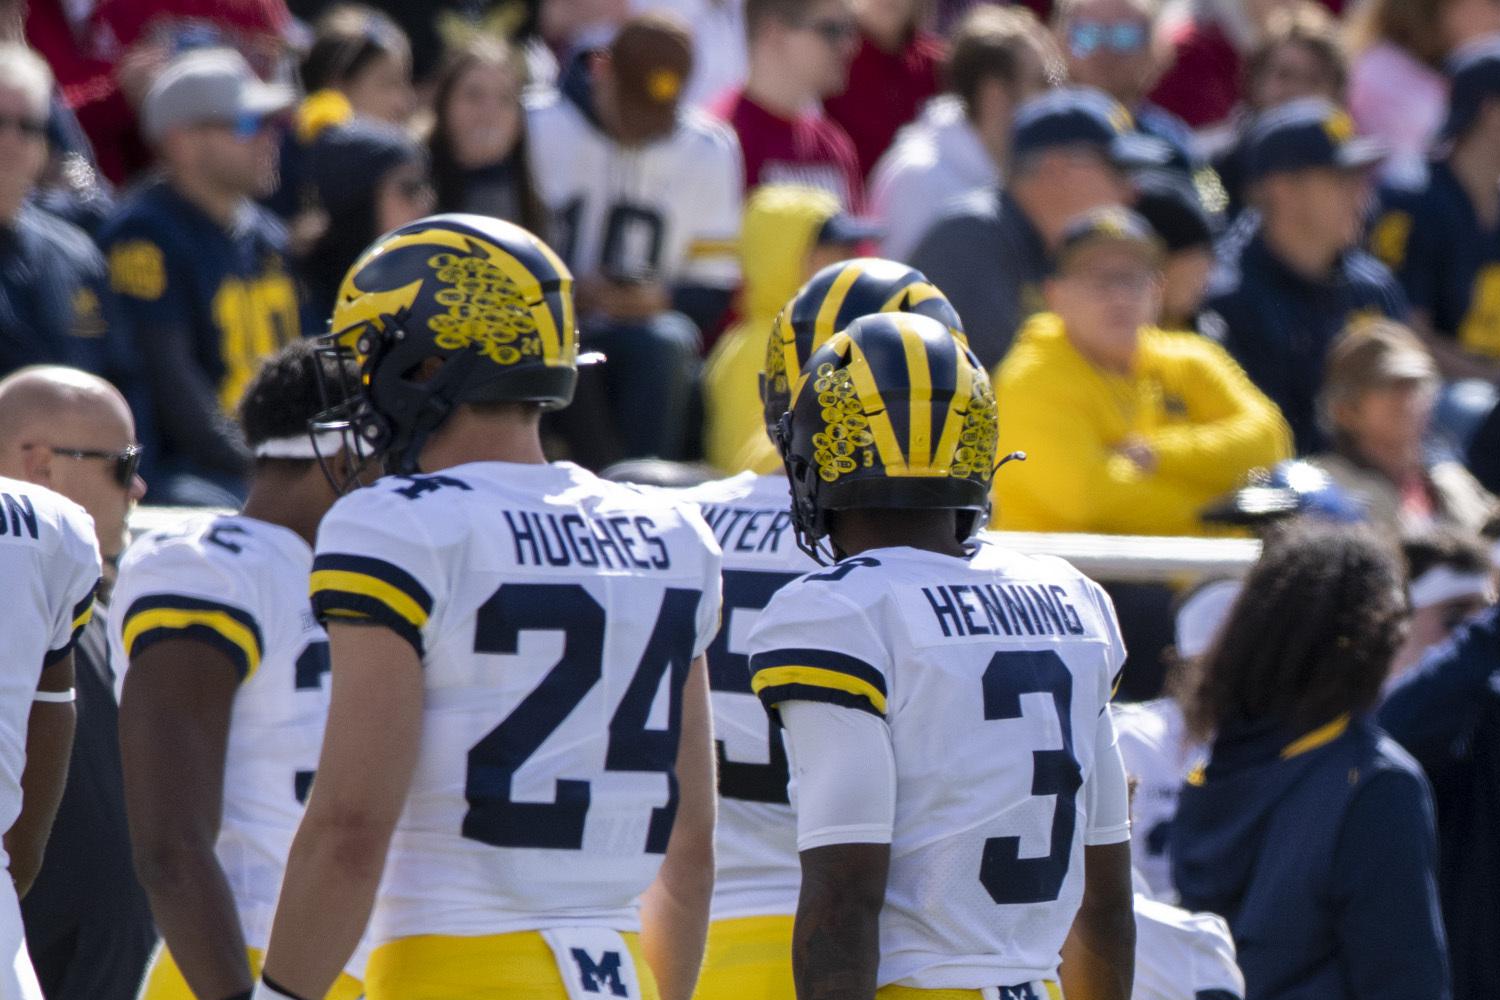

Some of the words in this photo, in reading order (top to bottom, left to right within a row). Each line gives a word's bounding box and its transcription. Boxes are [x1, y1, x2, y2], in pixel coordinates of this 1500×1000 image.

[502, 510, 671, 570] HUGHES
[921, 584, 1085, 637] HENNING
[462, 583, 704, 853] 24
[979, 649, 1083, 905] 3
[570, 946, 629, 999] M
